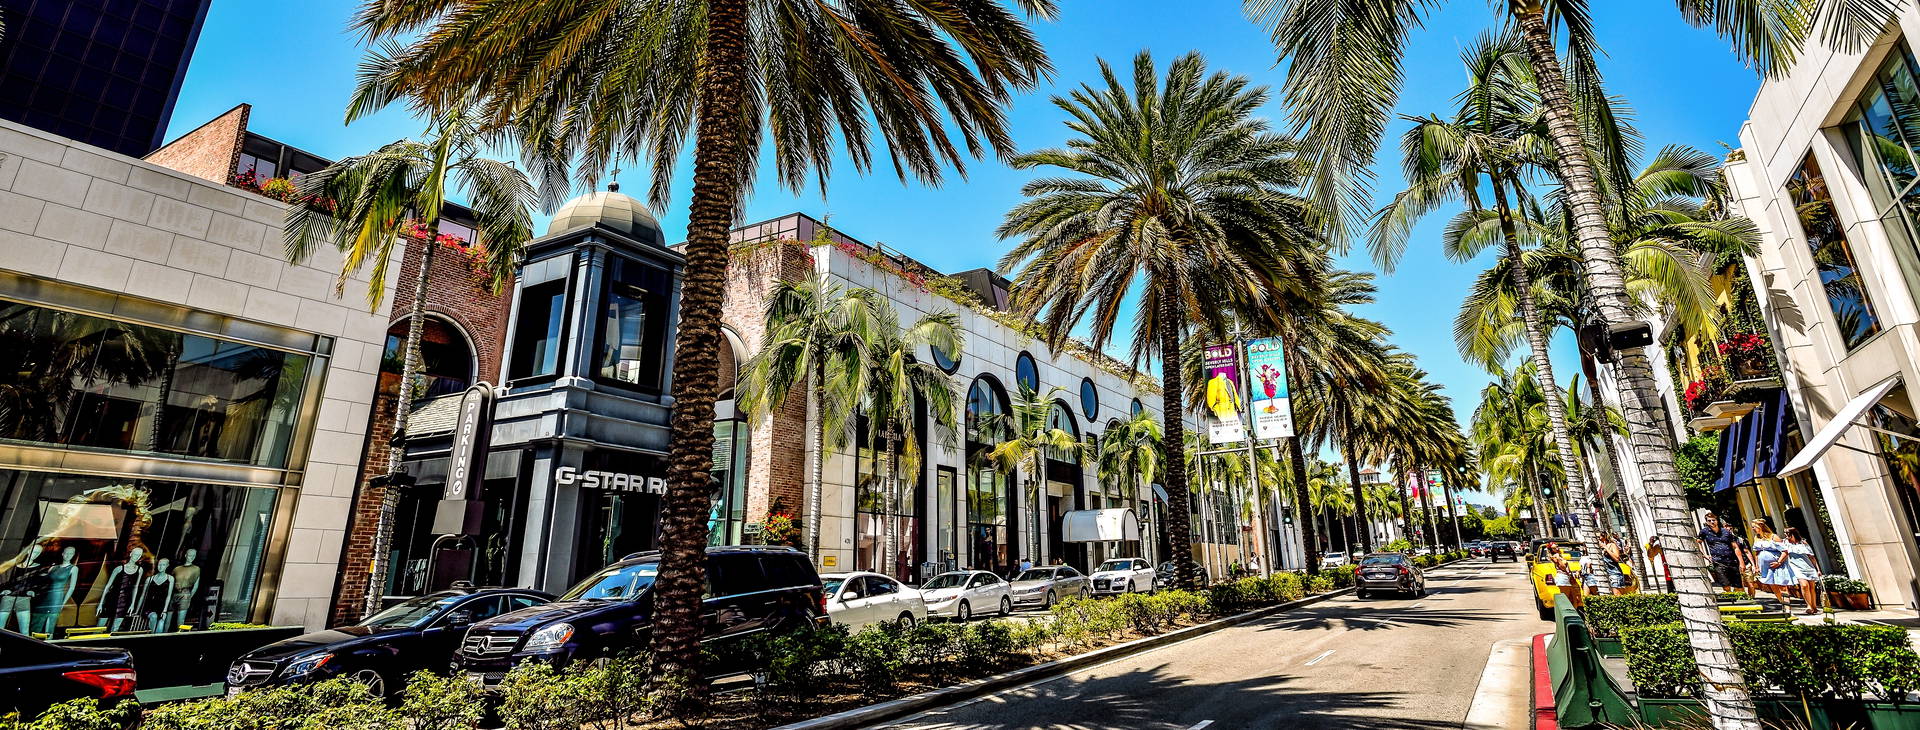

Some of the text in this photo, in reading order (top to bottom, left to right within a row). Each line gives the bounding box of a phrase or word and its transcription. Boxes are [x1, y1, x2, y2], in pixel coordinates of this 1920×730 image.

[1204, 348, 1233, 360] BOLD
[1250, 342, 1280, 353] BOLD
[455, 403, 475, 479] PARKING
[555, 466, 644, 493] G-STAR
